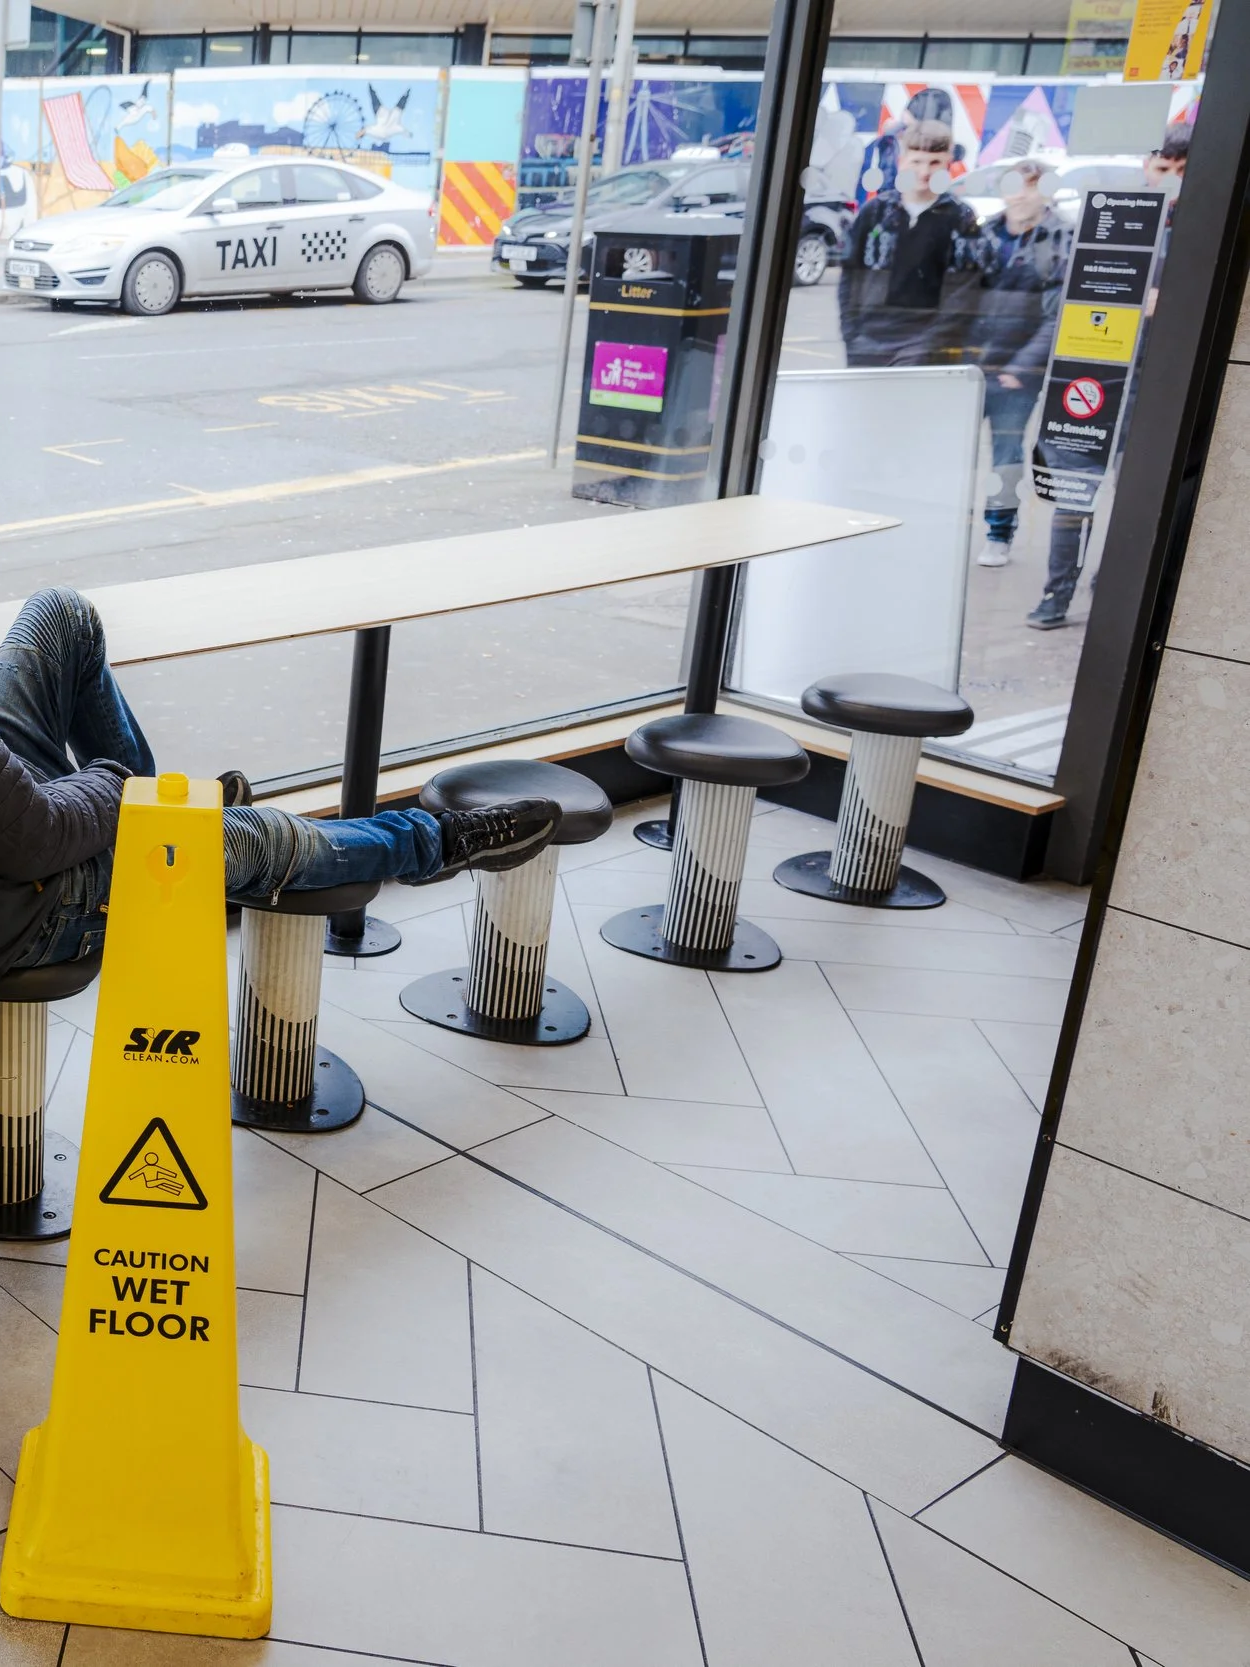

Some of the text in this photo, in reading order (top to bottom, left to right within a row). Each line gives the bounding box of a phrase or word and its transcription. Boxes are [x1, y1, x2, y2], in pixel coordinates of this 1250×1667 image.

[216, 236, 277, 271] TAXI
[621, 284, 653, 299] Litter
[1047, 421, 1108, 440] No Smoking
[123, 1027, 201, 1056] SIR
[123, 1052, 200, 1065] CLEAN.COM
[93, 1248, 210, 1274] CAUTION
[111, 1275, 190, 1306] WET
[88, 1308, 210, 1342] FLOOR
